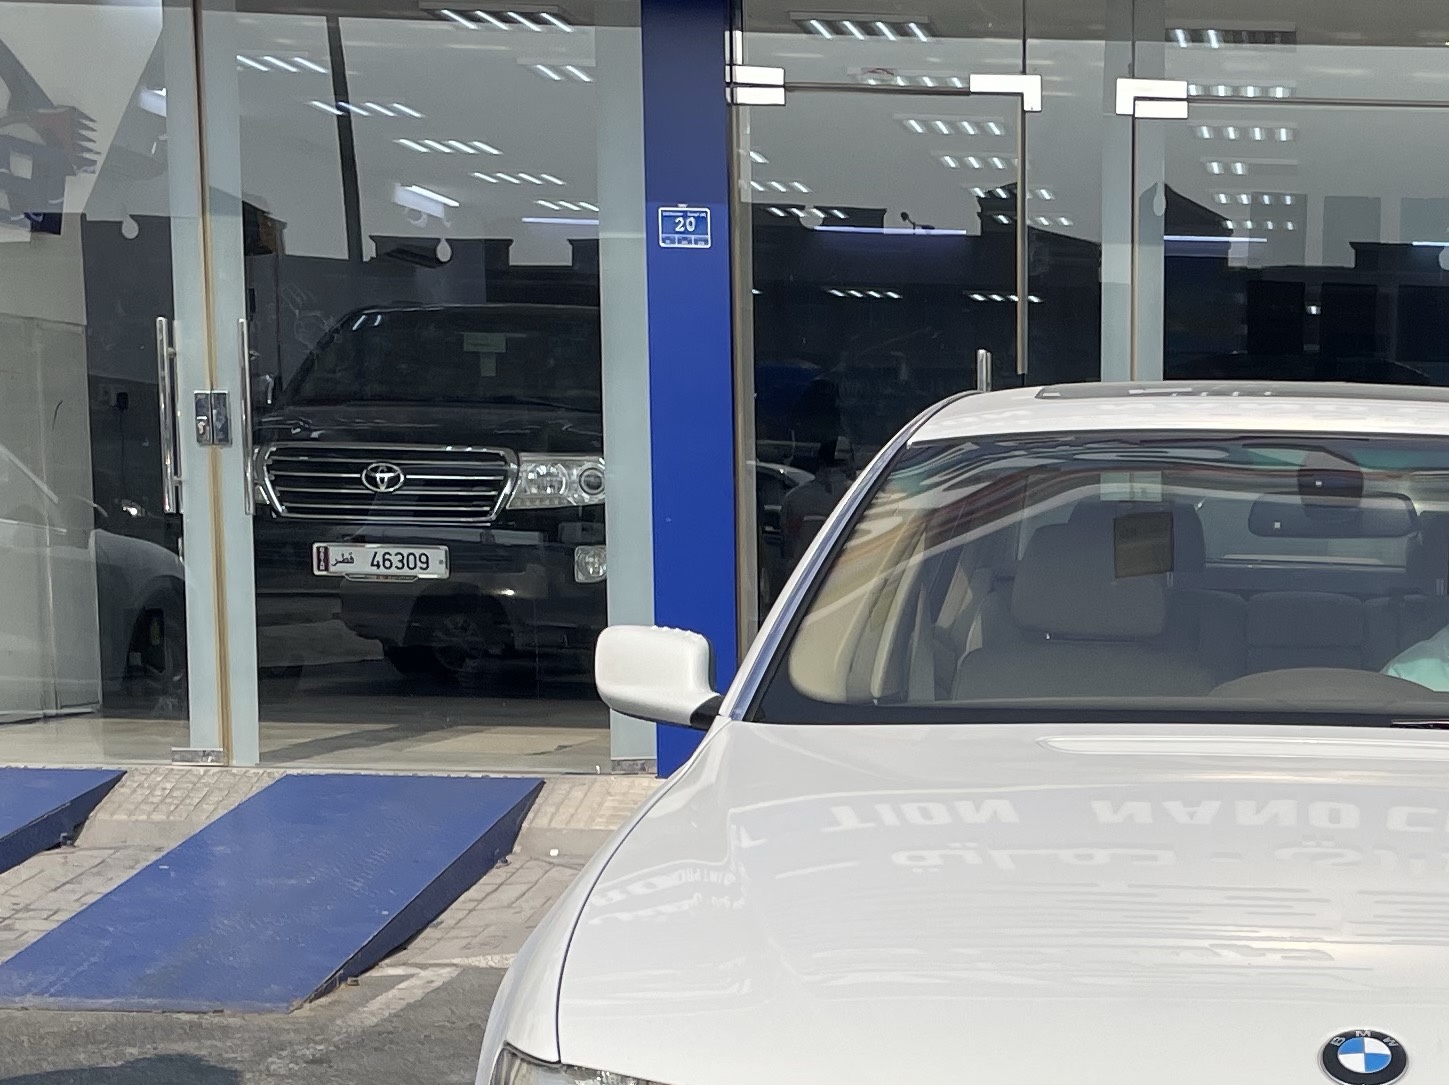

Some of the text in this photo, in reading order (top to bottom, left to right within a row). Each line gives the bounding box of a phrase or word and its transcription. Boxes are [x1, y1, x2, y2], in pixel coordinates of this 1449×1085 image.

[675, 217, 696, 232] 20
[331, 552, 355, 567] قطر
[370, 551, 430, 571] 46309
[1330, 1029, 1399, 1047] BMW
